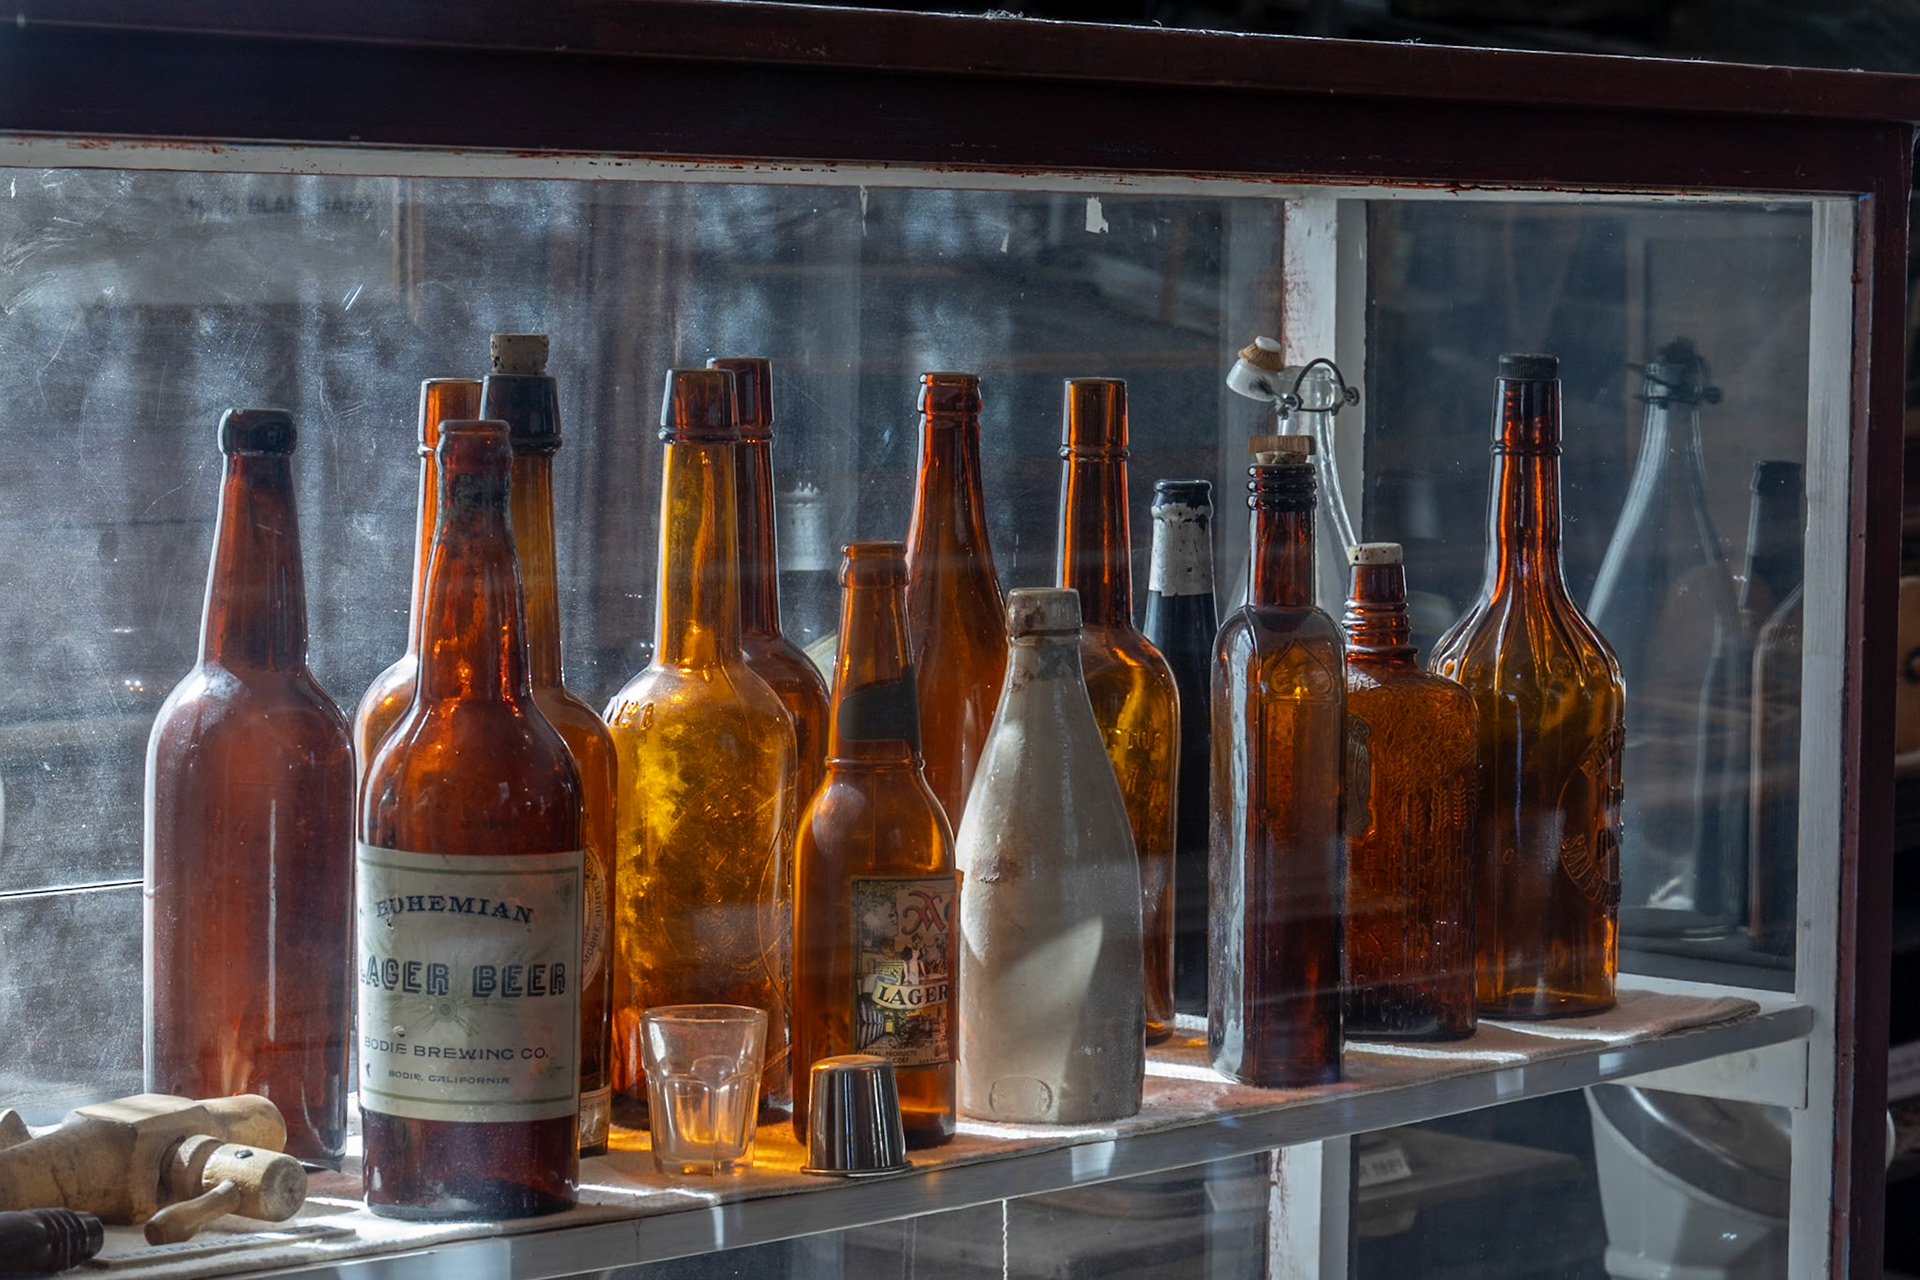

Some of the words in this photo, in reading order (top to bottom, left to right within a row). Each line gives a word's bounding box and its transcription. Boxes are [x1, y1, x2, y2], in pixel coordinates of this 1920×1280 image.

[375, 894, 534, 925] BOHEMIAN
[472, 962, 566, 998] BEER
[877, 983, 948, 1006] LAGER
[364, 1035, 407, 1055] BODIE
[413, 1045, 515, 1061] BREWING
[520, 1047, 549, 1060] CO.
[428, 1072, 511, 1085] CALIFORNIA
